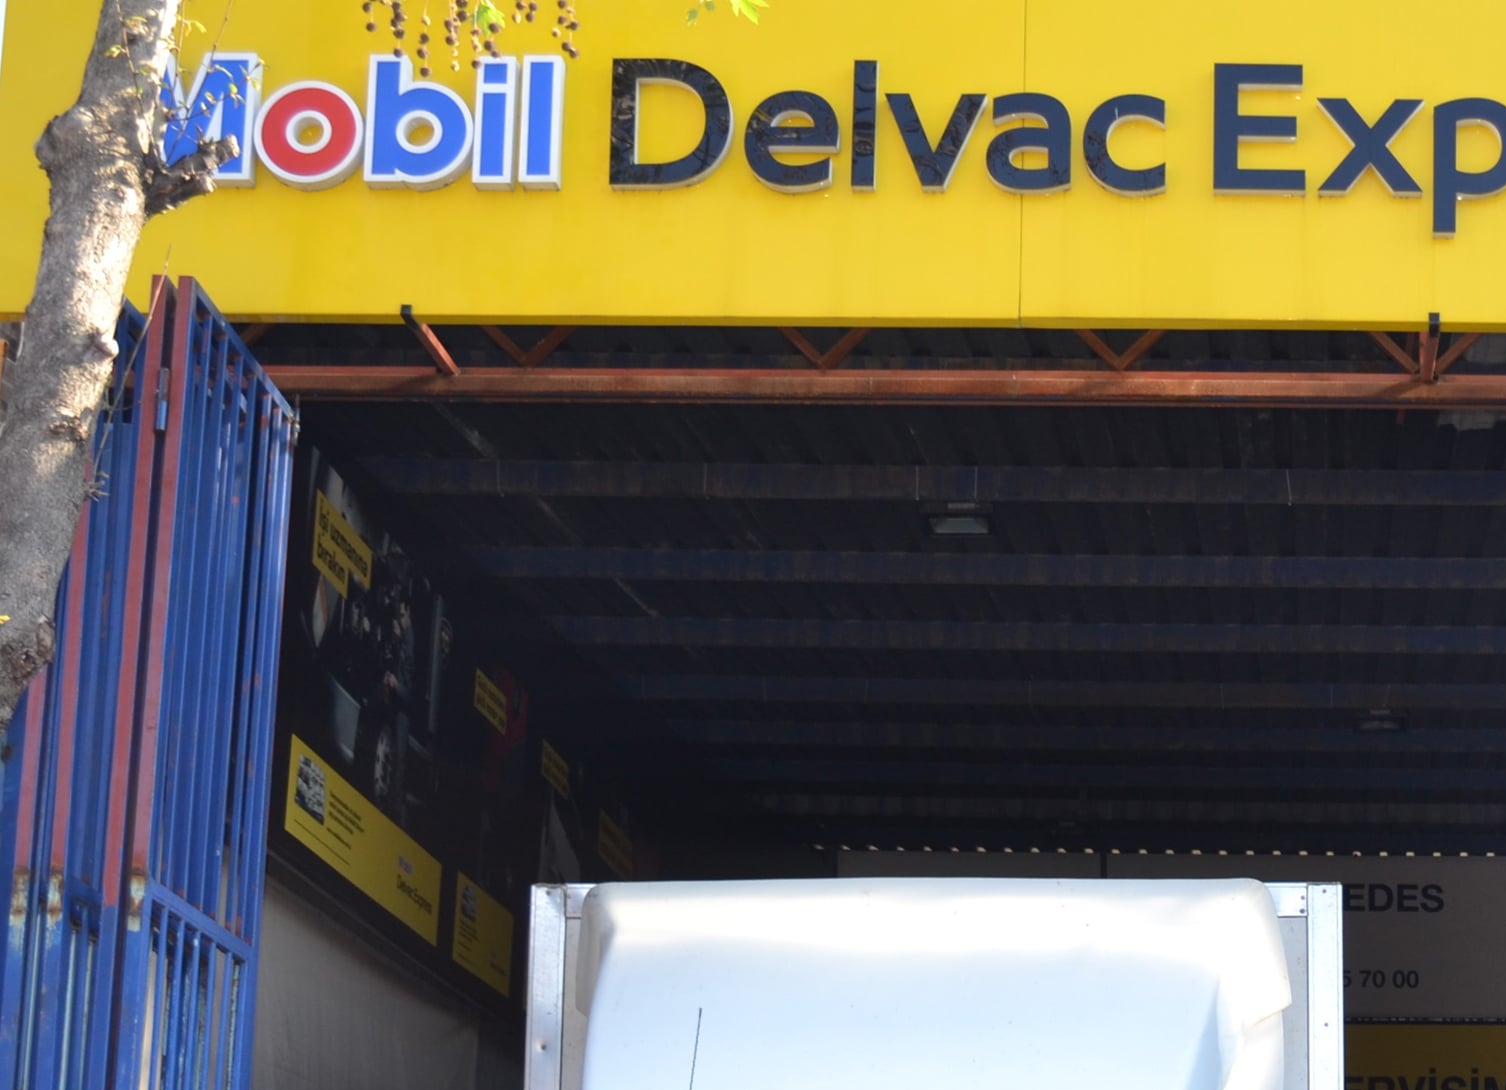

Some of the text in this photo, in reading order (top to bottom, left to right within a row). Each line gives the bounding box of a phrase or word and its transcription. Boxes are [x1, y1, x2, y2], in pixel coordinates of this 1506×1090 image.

[158, 52, 565, 191] Mobil
[608, 56, 1167, 198] Delvac
[1359, 970, 1386, 989] 70
[1392, 970, 1419, 989] 00
